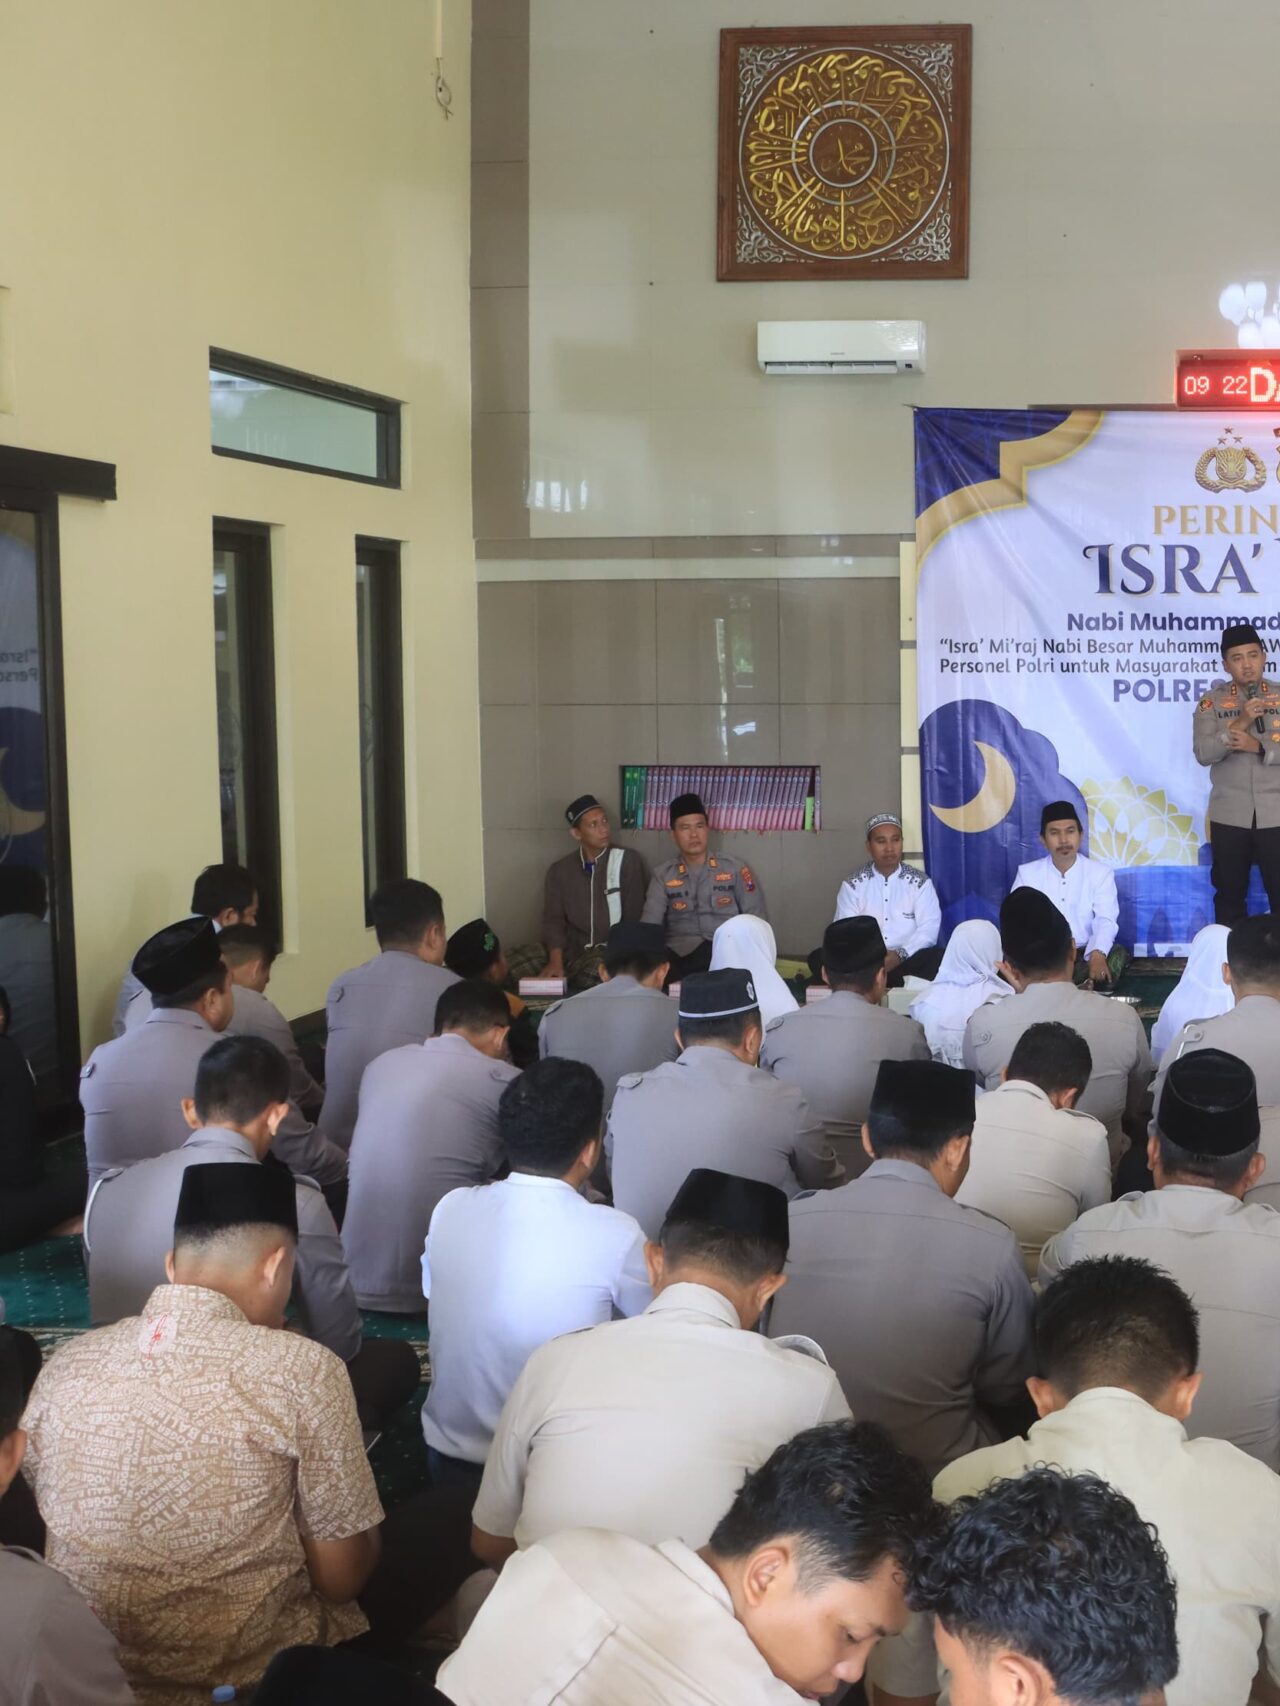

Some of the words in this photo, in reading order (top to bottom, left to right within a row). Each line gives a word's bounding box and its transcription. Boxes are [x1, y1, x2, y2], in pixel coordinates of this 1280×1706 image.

[1184, 376, 1210, 395] 09
[1222, 375, 1248, 395] 22
[1067, 612, 1124, 631] Nabi
[1043, 638, 1081, 654] Nabi
[1087, 639, 1134, 654] Besar
[1140, 638, 1222, 654] Muhamm
[940, 658, 1010, 674] Personel
[1016, 657, 1055, 673] Polri
[1060, 657, 1110, 673] untuk
[1116, 657, 1218, 677] Masyarakat
